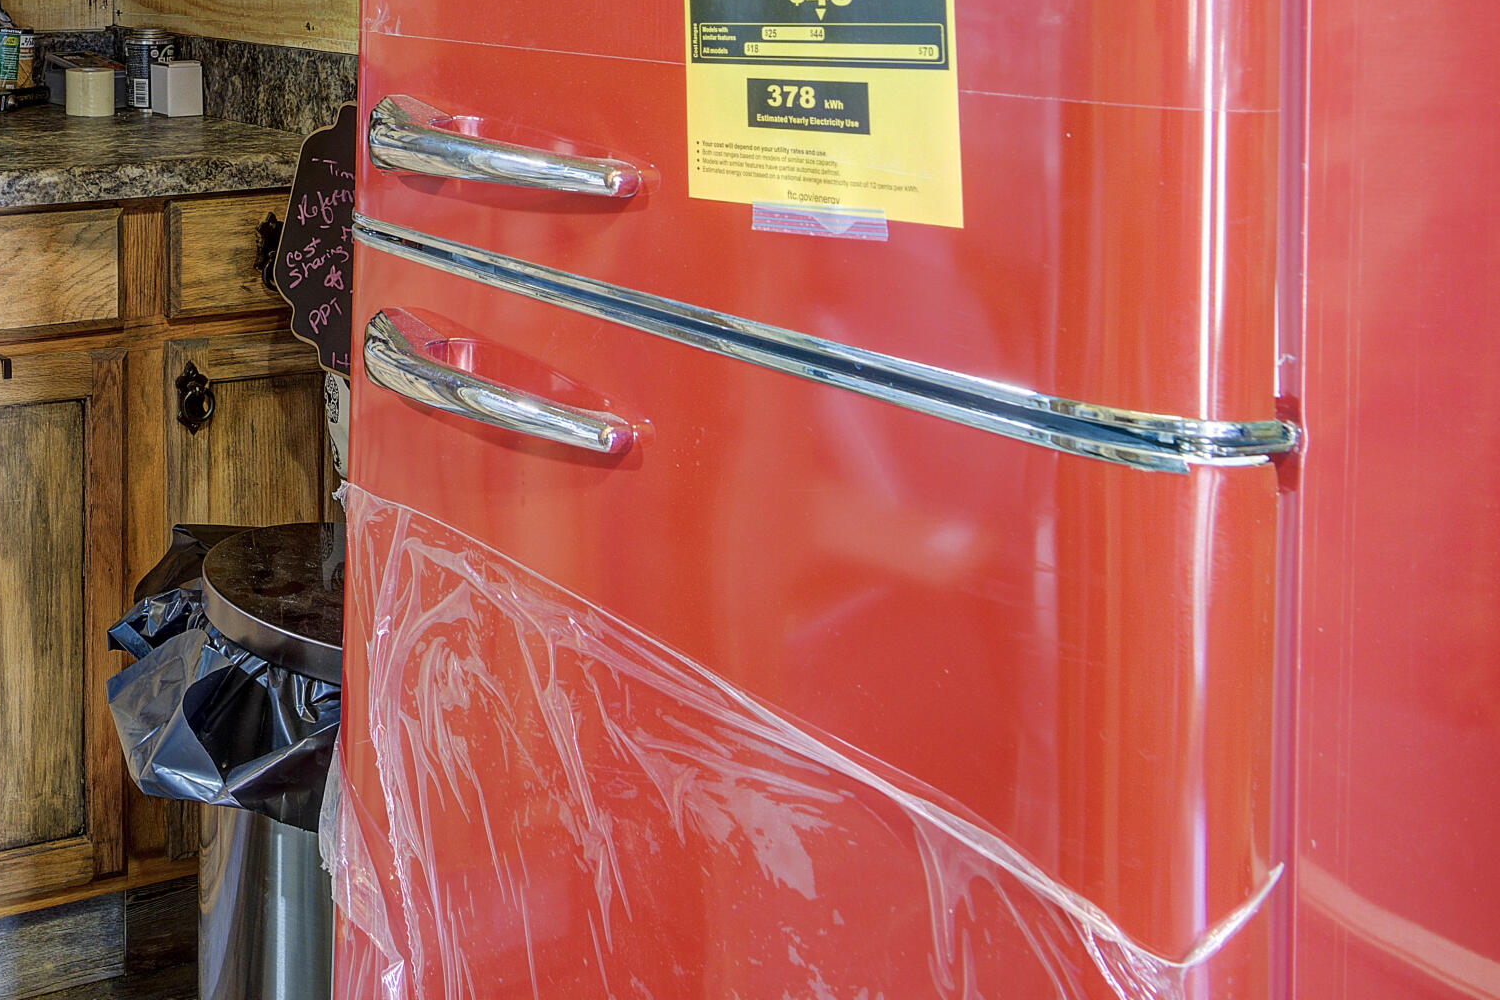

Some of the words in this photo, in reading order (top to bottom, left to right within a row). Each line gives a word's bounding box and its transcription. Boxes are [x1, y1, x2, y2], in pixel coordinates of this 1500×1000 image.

[764, 29, 777, 38] $25
[810, 29, 823, 38] $44
[747, 44, 759, 53] $18
[919, 46, 934, 57] $70
[767, 84, 816, 109] 378
[824, 99, 844, 110] kWh
[756, 113, 788, 124] Estimated
[788, 115, 808, 126] Yearly
[810, 116, 845, 128] Electricity
[845, 118, 859, 128] Use
[774, 146, 789, 155] utility
[323, 159, 354, 180] Tim
[745, 161, 765, 170] features
[796, 166, 820, 175] automatic
[702, 166, 725, 174] Estimated
[726, 168, 741, 177] energy
[752, 170, 768, 178] based
[803, 176, 822, 185] average
[823, 178, 848, 188] electricity
[787, 190, 840, 204] ftc.gov/energy
[308, 297, 342, 334] PPT
